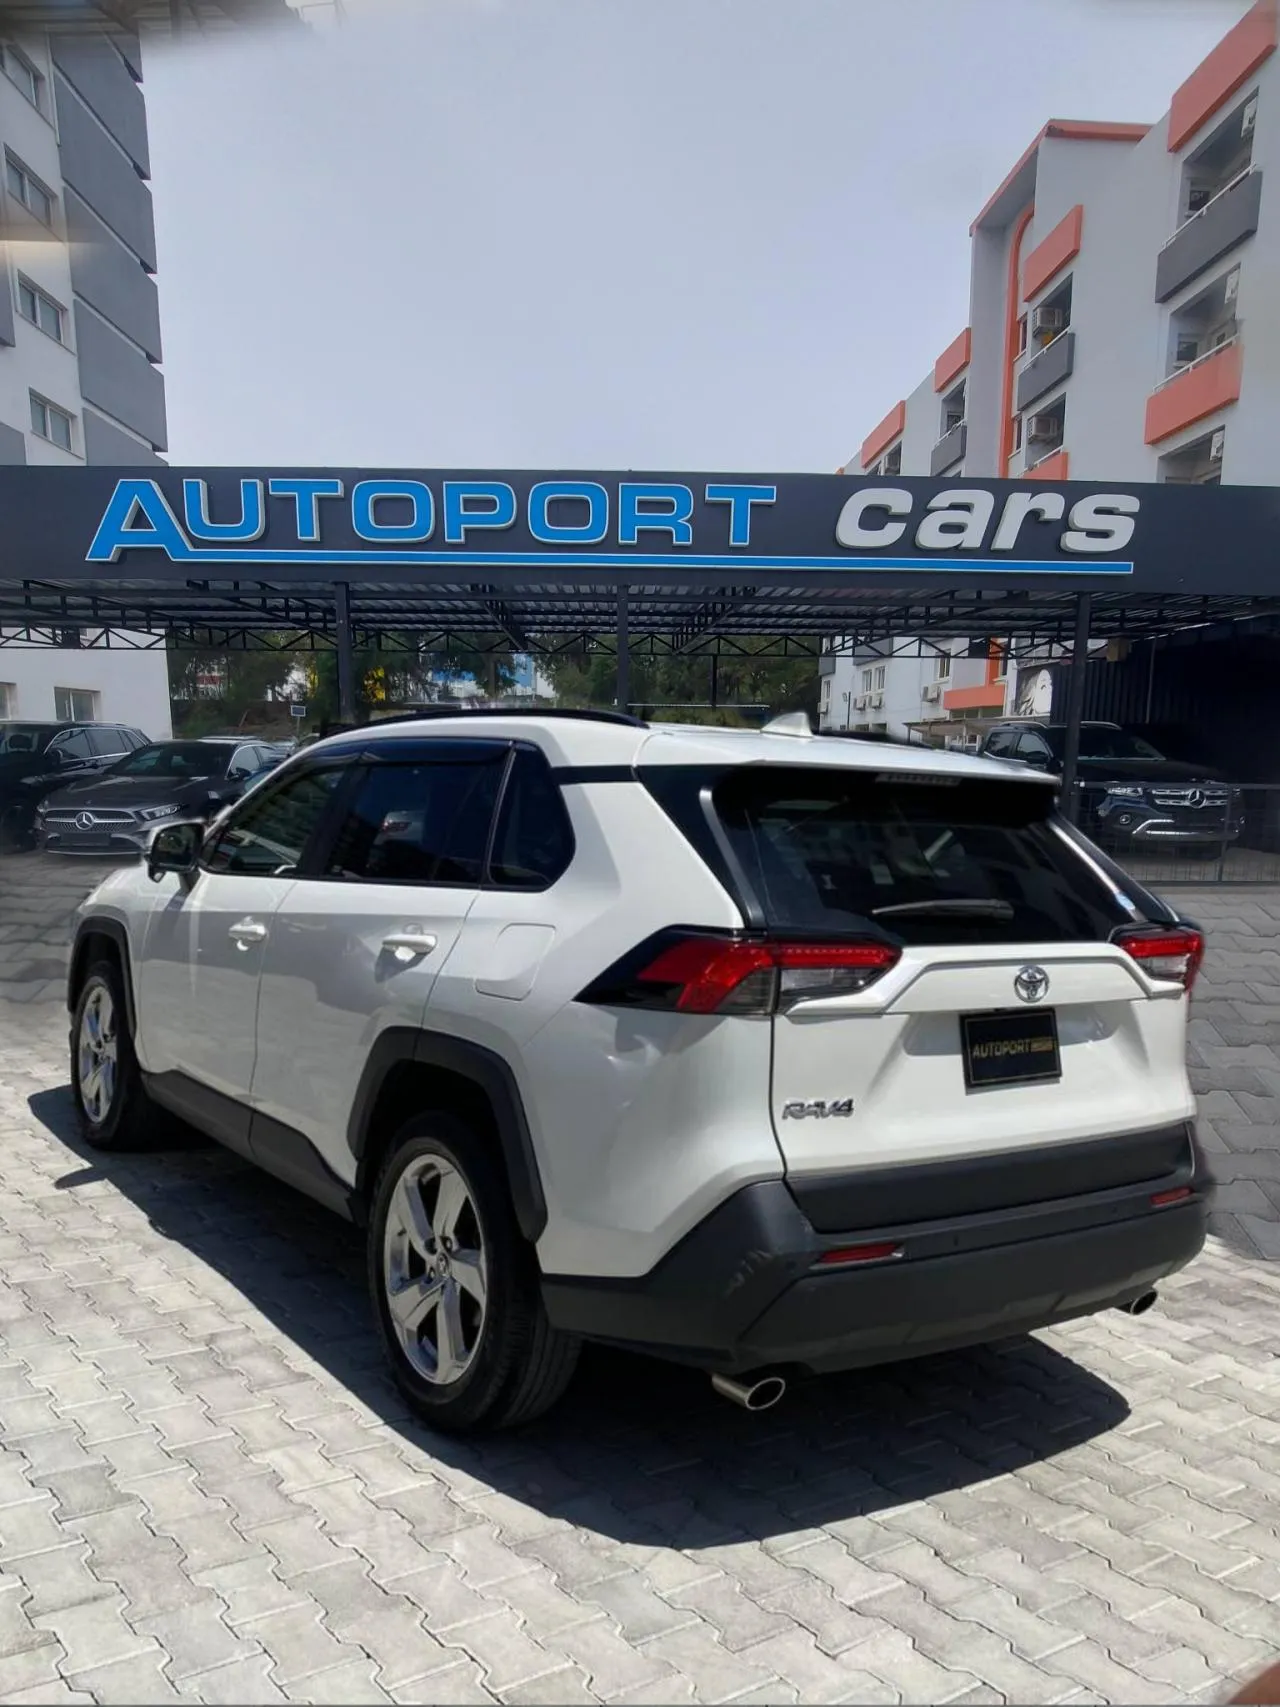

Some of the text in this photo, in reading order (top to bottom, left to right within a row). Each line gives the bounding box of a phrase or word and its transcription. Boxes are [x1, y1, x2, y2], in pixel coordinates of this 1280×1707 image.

[85, 477, 1140, 563] AUTOPORT cars
[972, 1038, 1031, 1058] AUTOPORT
[782, 1098, 854, 1120] RAV4
